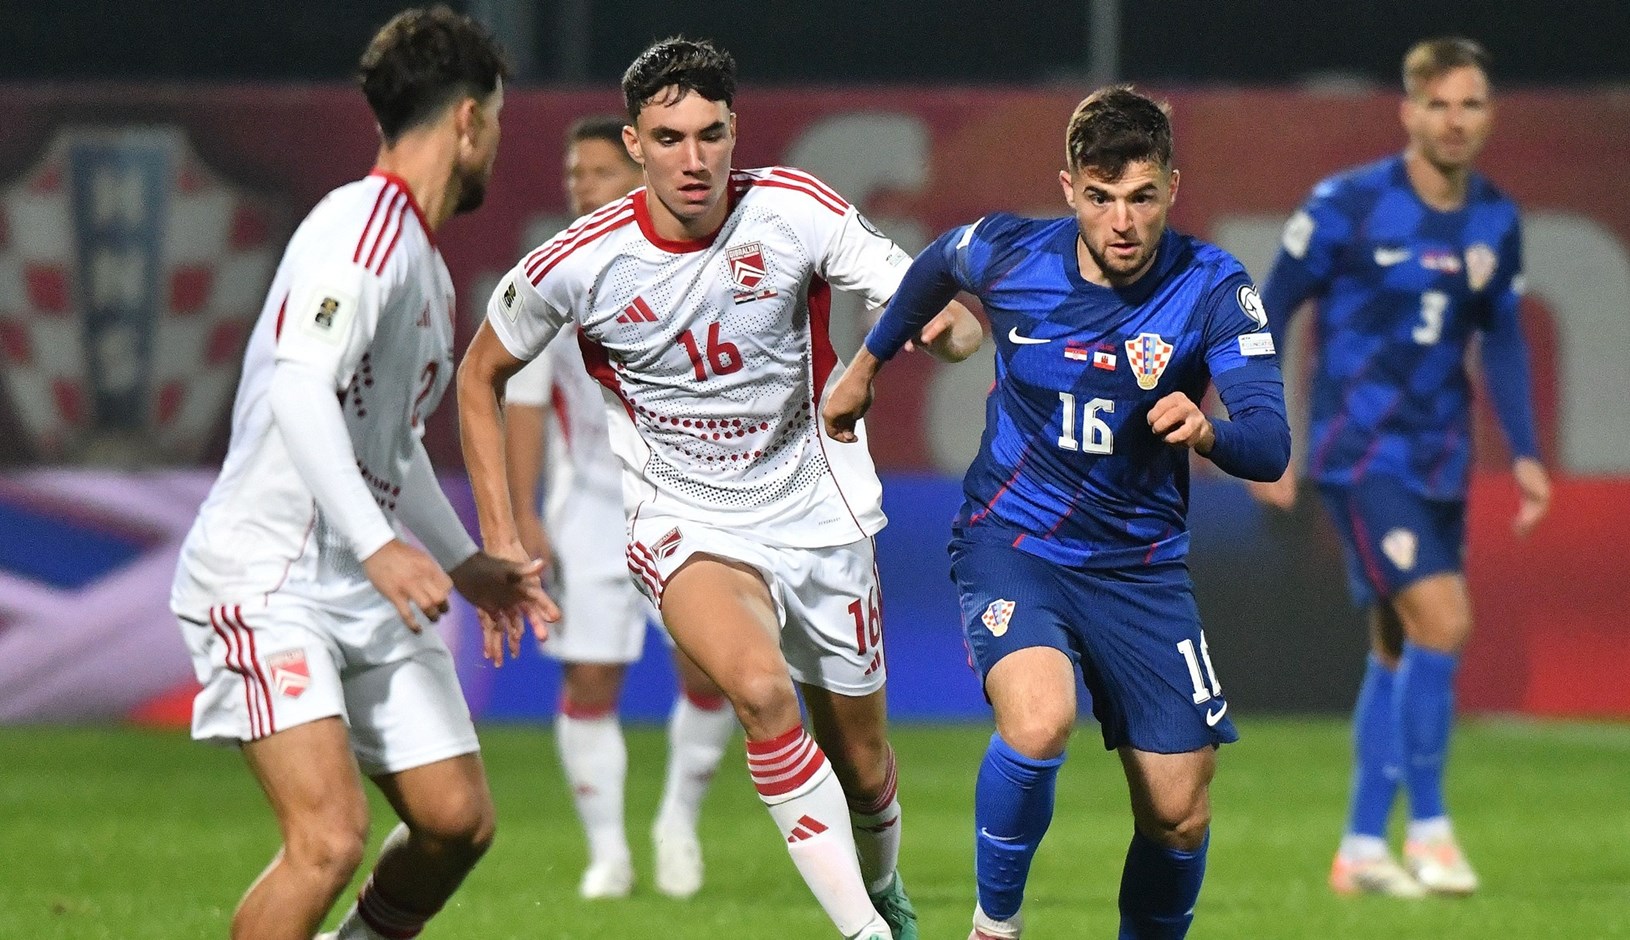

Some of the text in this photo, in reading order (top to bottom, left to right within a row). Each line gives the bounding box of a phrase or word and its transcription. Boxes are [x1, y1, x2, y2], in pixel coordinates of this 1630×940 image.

[1411, 290, 1449, 345] 3
[675, 321, 745, 382] 16
[1057, 391, 1115, 455] 16
[847, 585, 880, 656] 16
